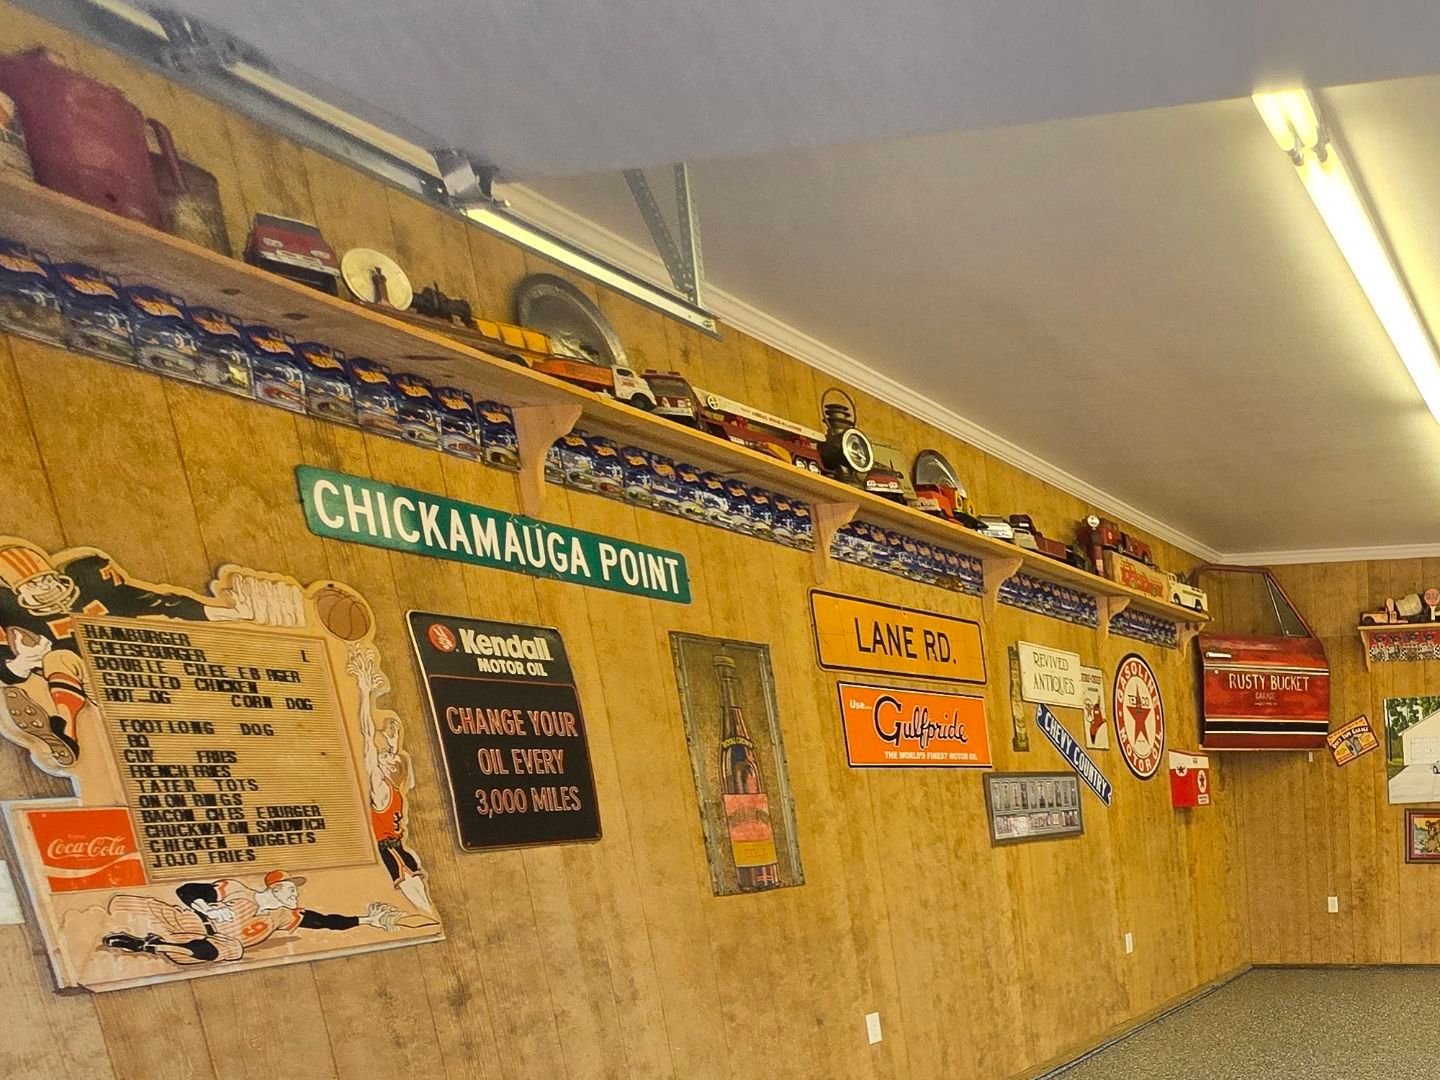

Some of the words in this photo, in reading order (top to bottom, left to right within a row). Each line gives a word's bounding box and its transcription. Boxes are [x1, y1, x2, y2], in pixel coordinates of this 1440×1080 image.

[313, 479, 591, 577] CHICKAMAUGA
[599, 543, 680, 595] POINT
[85, 625, 192, 647] HAMBURGER
[459, 628, 553, 661] Kendall
[854, 617, 917, 659] LANE
[923, 629, 957, 664] RD.
[88, 640, 208, 663] CHEESEBURGER
[1033, 651, 1069, 672] REVIVED
[478, 658, 525, 675] MOTOR
[527, 662, 548, 677] OIL
[102, 672, 181, 690] GRILLED
[194, 678, 258, 694] CHICKEN
[1033, 674, 1075, 696] ANTIQUES
[1117, 661, 1159, 707] GASOLINE
[1229, 673, 1265, 690] RUSTY
[1270, 675, 1309, 691] BUCKET
[231, 694, 273, 709] CORN
[285, 698, 313, 710] DOG
[240, 723, 274, 736] DOG
[446, 706, 526, 736] CHANGE
[527, 710, 578, 737] YOUR
[873, 695, 968, 749] Gulfpride
[884, 751, 898, 760] THE
[899, 751, 926, 760] WORLD'S
[927, 752, 948, 760] FINEST
[1044, 711, 1072, 756] CHEVY
[1073, 746, 1107, 798] COUNTRY
[1119, 728, 1151, 772] MOTOR
[1152, 730, 1163, 759] OIL
[196, 750, 237, 764] FRIES
[478, 748, 509, 775] OIL
[511, 749, 564, 775] EVERY
[129, 764, 189, 779] FRENCH
[193, 765, 231, 779] FRIES
[136, 779, 196, 793] TATER
[214, 779, 259, 792] TOTS
[475, 788, 528, 820] 3,000
[531, 786, 581, 812] MILES
[141, 808, 194, 823] BACON
[256, 818, 325, 834] SANDWICH
[151, 836, 227, 853] CHICKEN
[247, 832, 316, 848] NUGGETS
[153, 853, 198, 868] JOJO
[208, 849, 256, 864] FRIES
